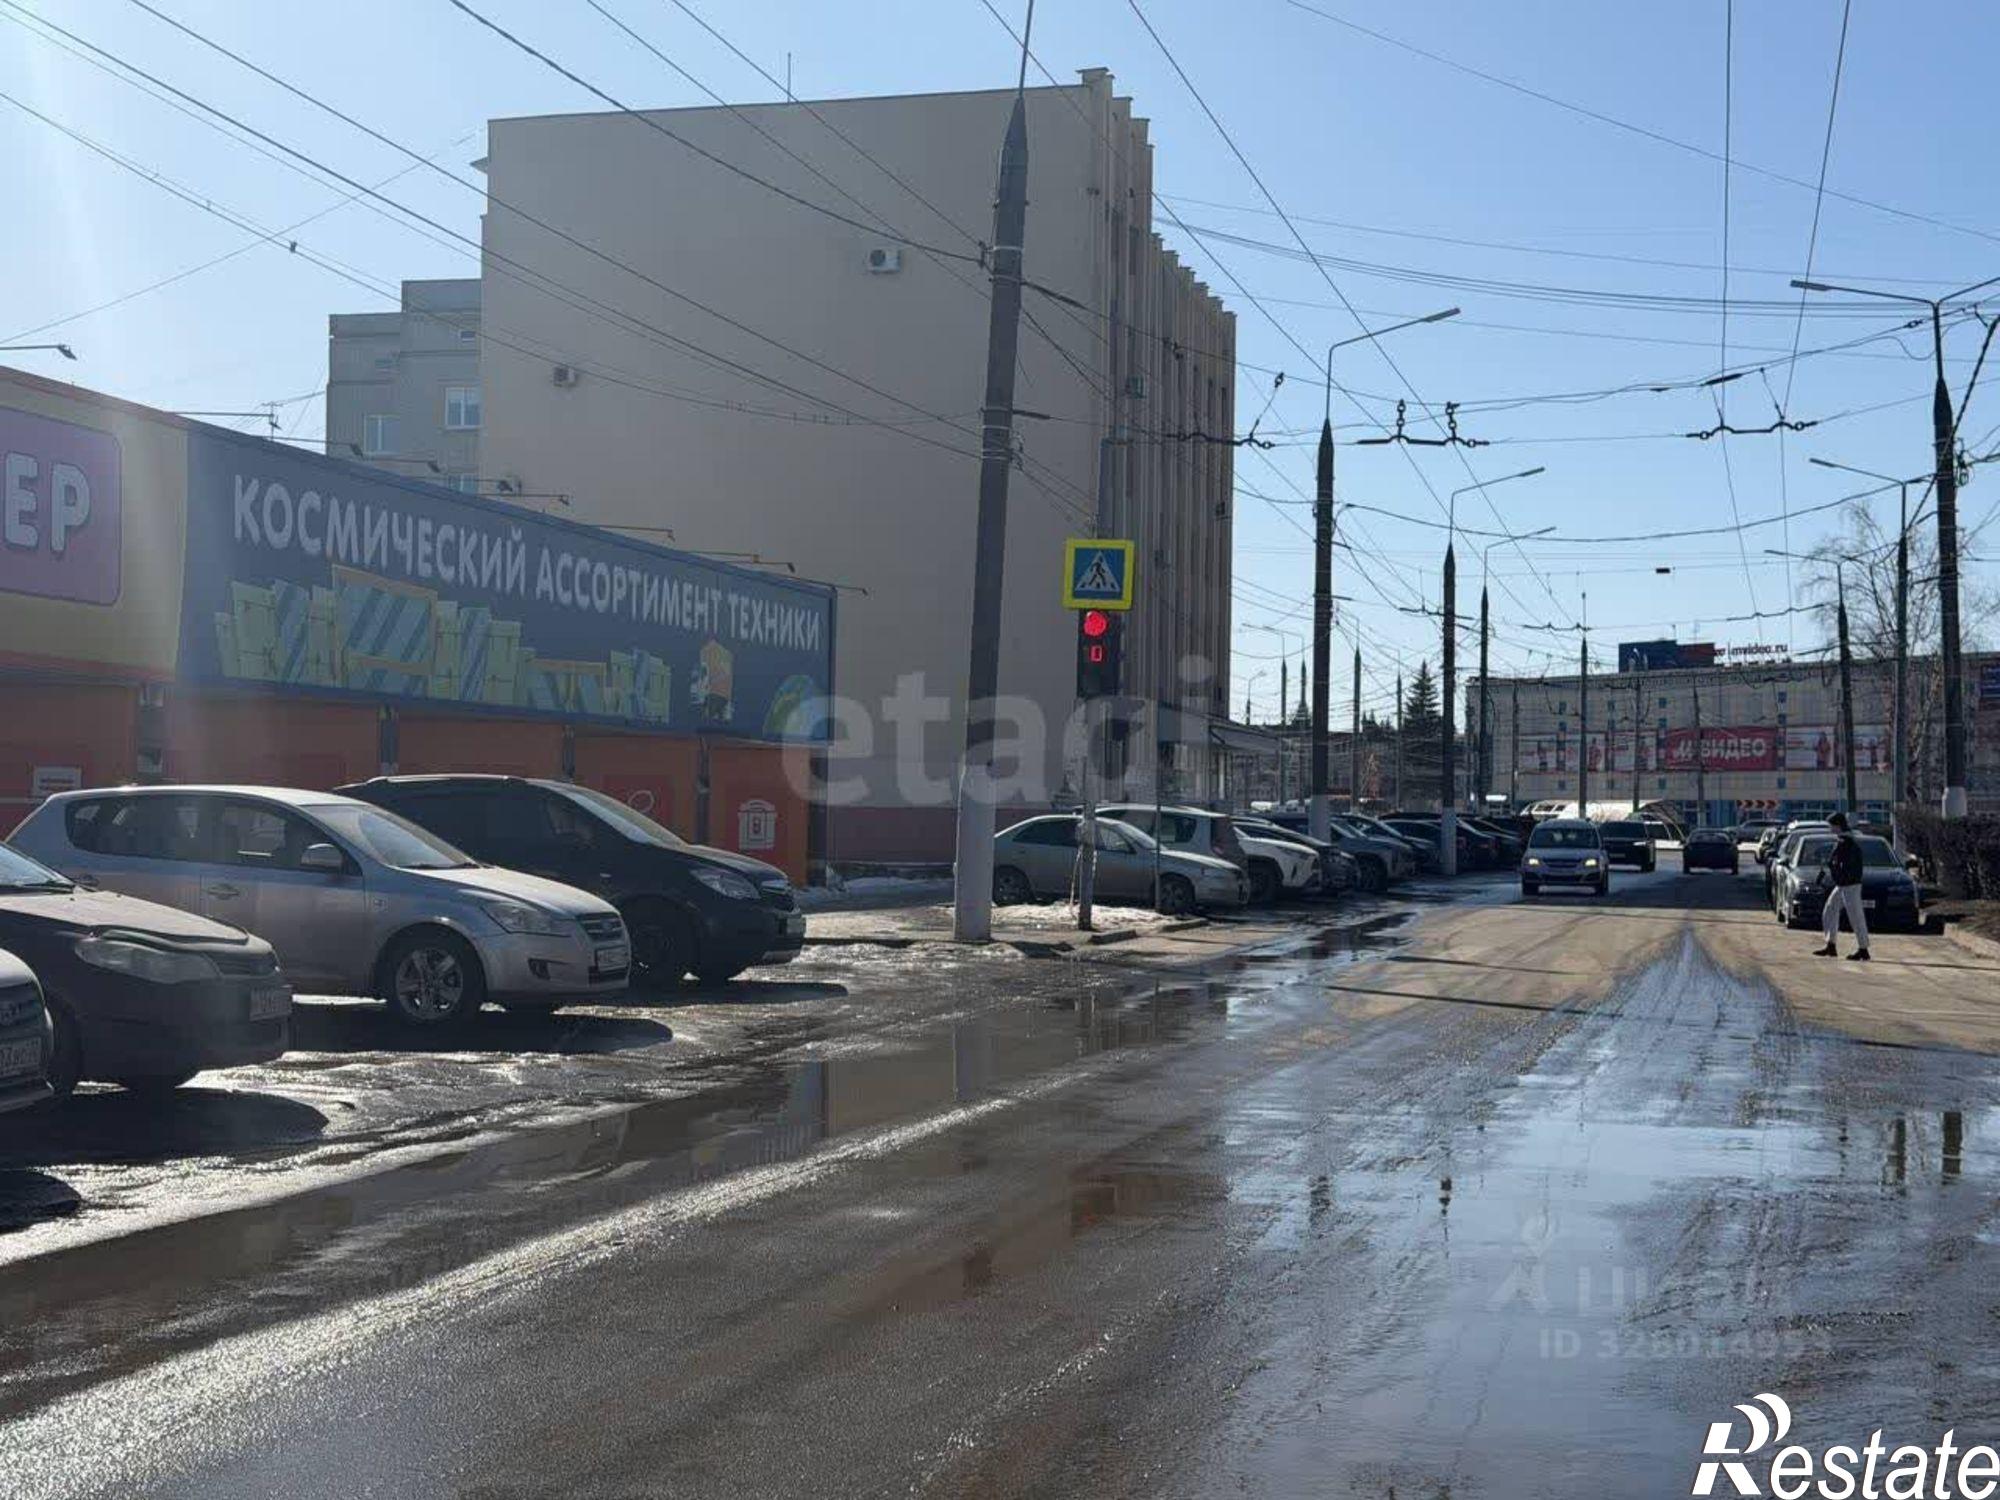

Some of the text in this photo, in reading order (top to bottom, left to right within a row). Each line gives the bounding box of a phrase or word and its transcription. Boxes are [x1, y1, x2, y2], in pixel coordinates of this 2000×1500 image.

[233, 473, 820, 651] КОСМИЧЕСКИЙ АССОРТИМЕНТ ТЕХНИКИ
